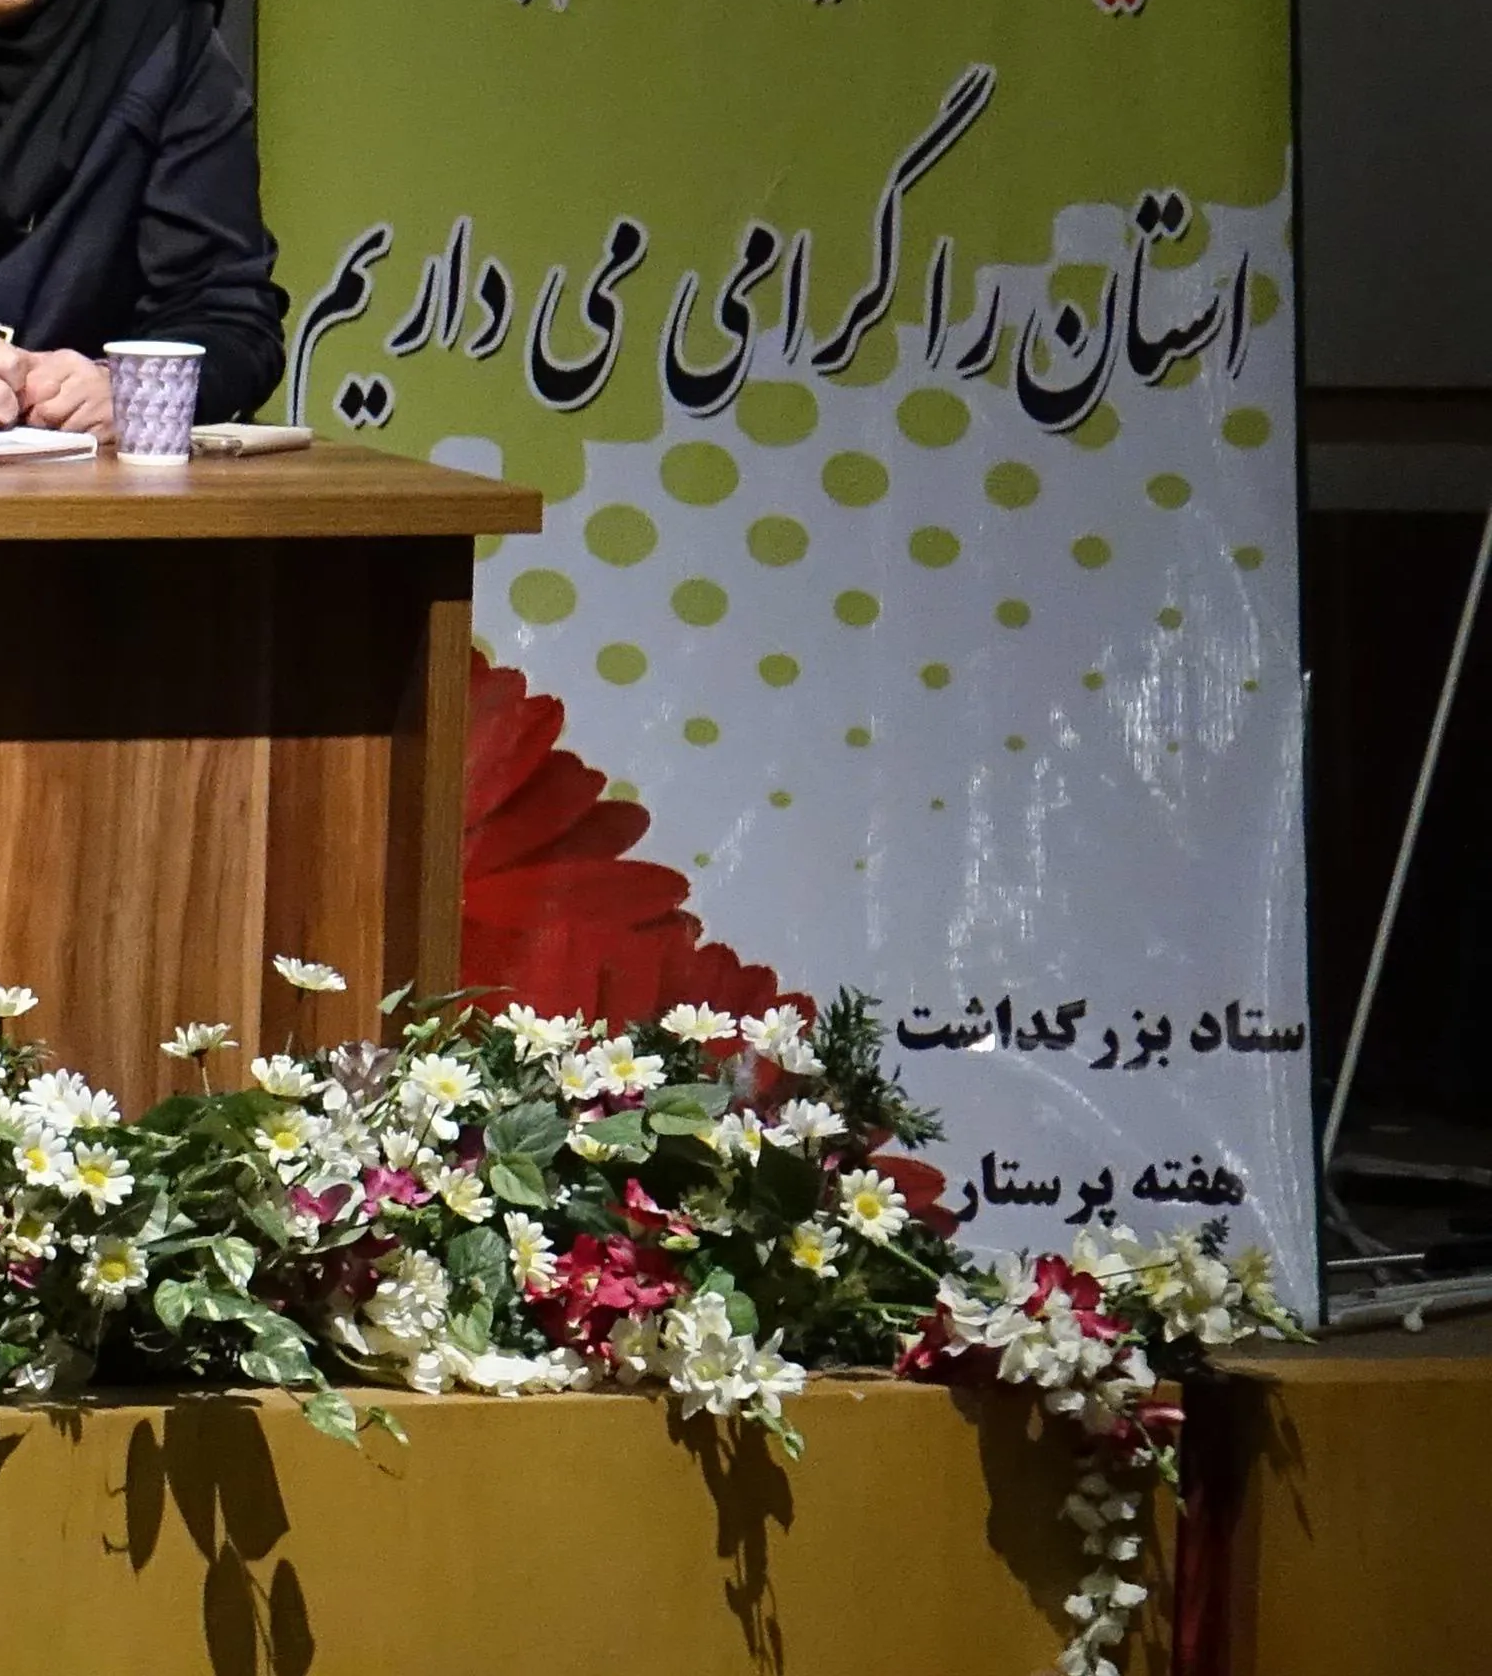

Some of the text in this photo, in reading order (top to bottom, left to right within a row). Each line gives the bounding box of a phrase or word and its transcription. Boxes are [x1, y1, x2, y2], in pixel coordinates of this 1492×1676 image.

[286, 63, 1252, 433] استان را گرامی می داریم
[1189, 999, 1306, 1053] ستاد
[955, 1150, 1247, 1227] هفته پرستار
